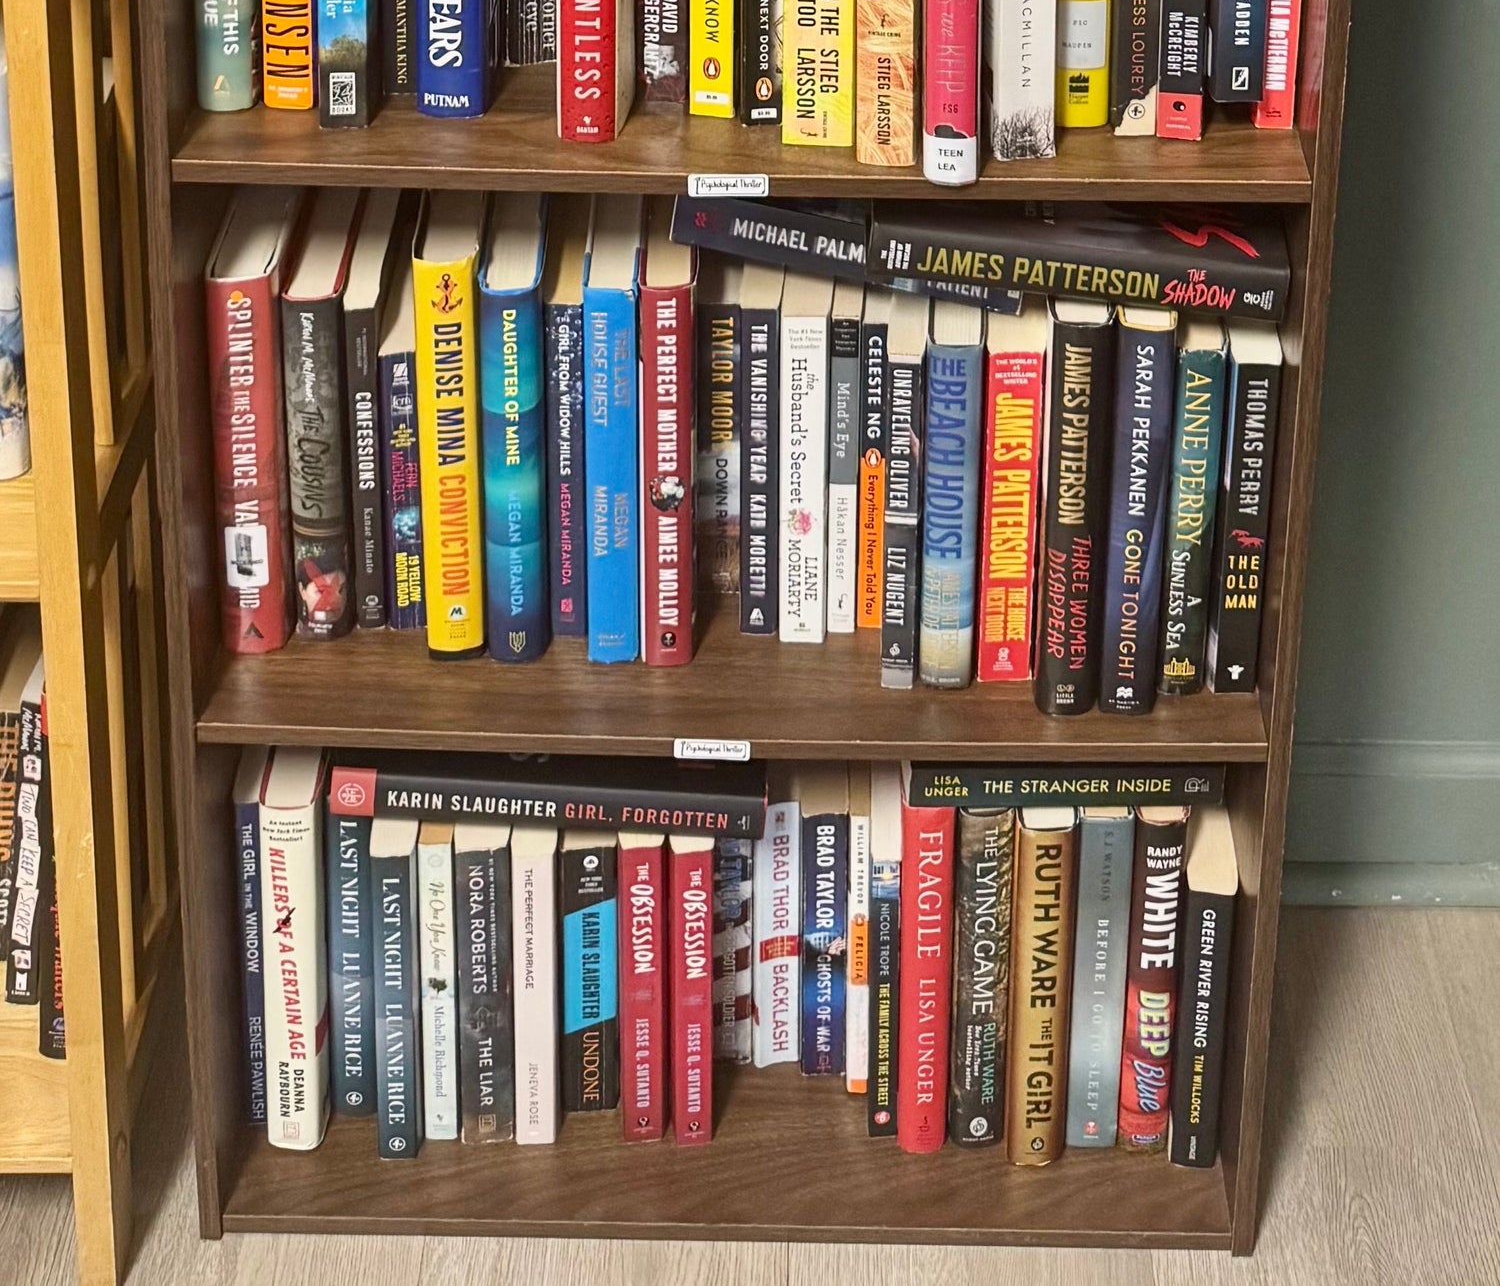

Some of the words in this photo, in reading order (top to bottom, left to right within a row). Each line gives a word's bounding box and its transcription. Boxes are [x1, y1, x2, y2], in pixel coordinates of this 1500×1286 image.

[424, 93, 469, 107] PUTNAM
[938, 148, 963, 157] TEEN
[937, 162, 956, 171] LEA
[917, 246, 1003, 280] JAMES
[1012, 256, 1160, 299] PATTERSON
[1187, 268, 1207, 282] THE
[1161, 280, 1237, 310] SHADOW
[433, 323, 463, 398] DENISE
[502, 308, 518, 398] DAUGHTER
[504, 400, 519, 421] OF
[437, 407, 465, 467] MINA
[505, 424, 521, 466] MINE
[1228, 556, 1260, 572] THE
[1227, 574, 1259, 590] OLD
[1225, 592, 1258, 609] MAN
[933, 775, 960, 786] LISA
[983, 780, 1014, 794] THE
[1020, 778, 1110, 794] STRANGER
[1116, 779, 1171, 793] INSIDE
[924, 786, 969, 797] UNGER
[387, 790, 443, 810] KARIN
[450, 796, 557, 818] SLAUGHTER
[565, 803, 613, 823] GIRL,
[622, 807, 728, 829] FORGOTTEN
